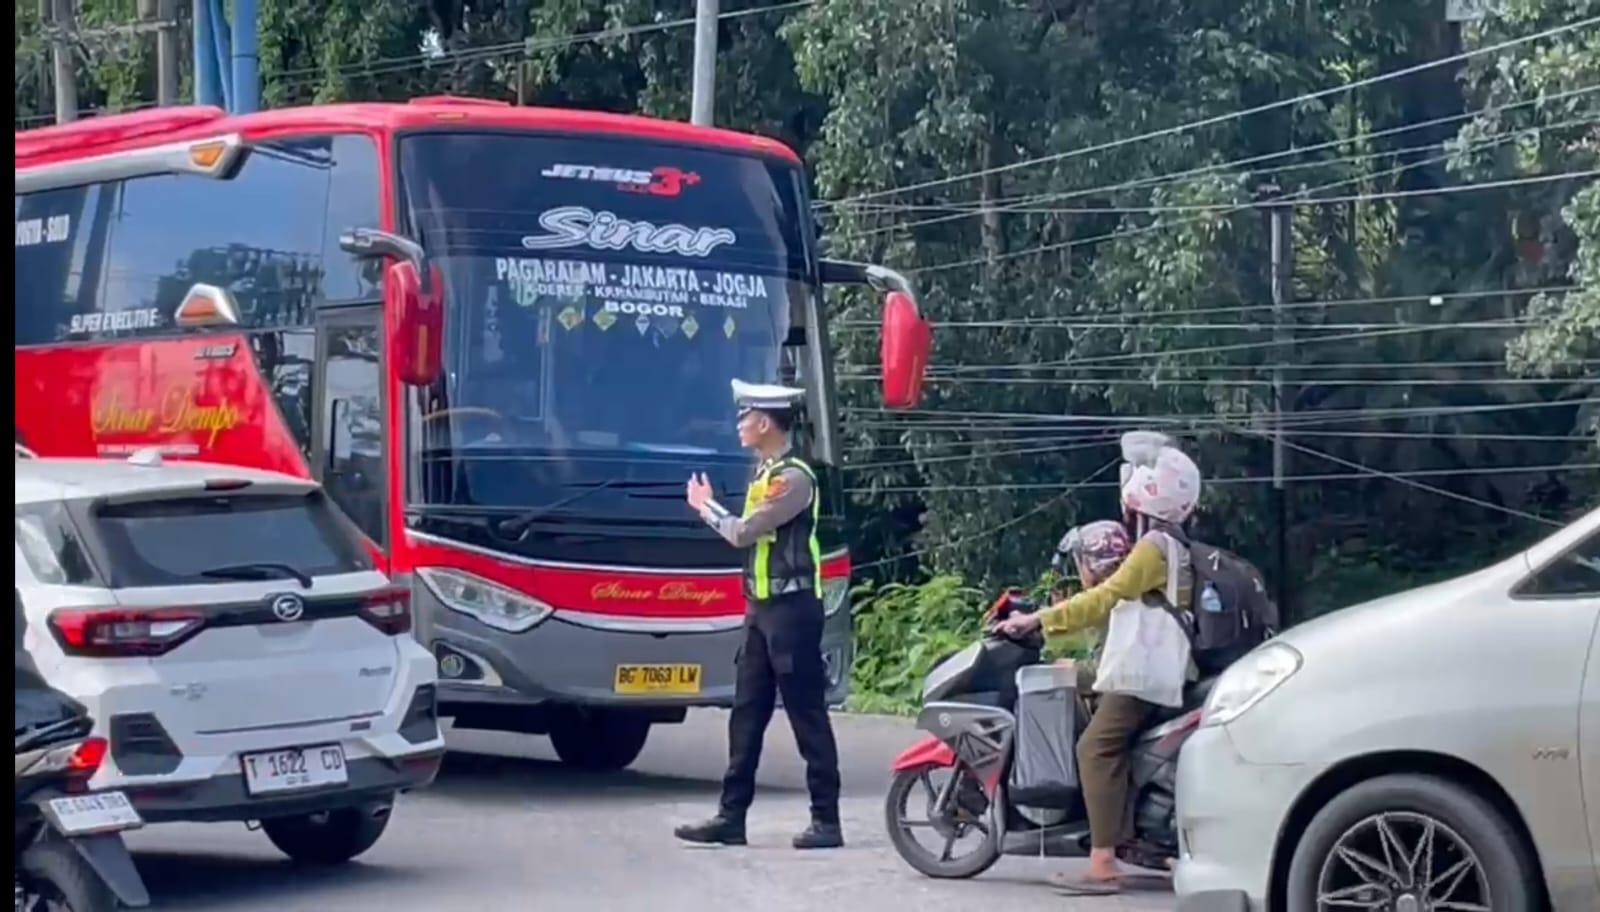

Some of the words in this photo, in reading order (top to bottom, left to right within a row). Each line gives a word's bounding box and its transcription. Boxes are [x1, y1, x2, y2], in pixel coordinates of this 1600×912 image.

[522, 206, 736, 257] Sinar
[496, 257, 606, 285] PAGARALAM
[620, 264, 700, 292] JAKARTA
[712, 271, 767, 298] JOGJA
[604, 300, 684, 318] BOGOR
[700, 292, 748, 308] BEKASI
[70, 313, 102, 333] SUPER
[103, 307, 159, 331] EXECUTIVE
[590, 580, 653, 600] Sinar
[657, 581, 728, 606] Dempo
[247, 758, 258, 779] T
[268, 751, 308, 777] 1622
[321, 749, 342, 770] CD
